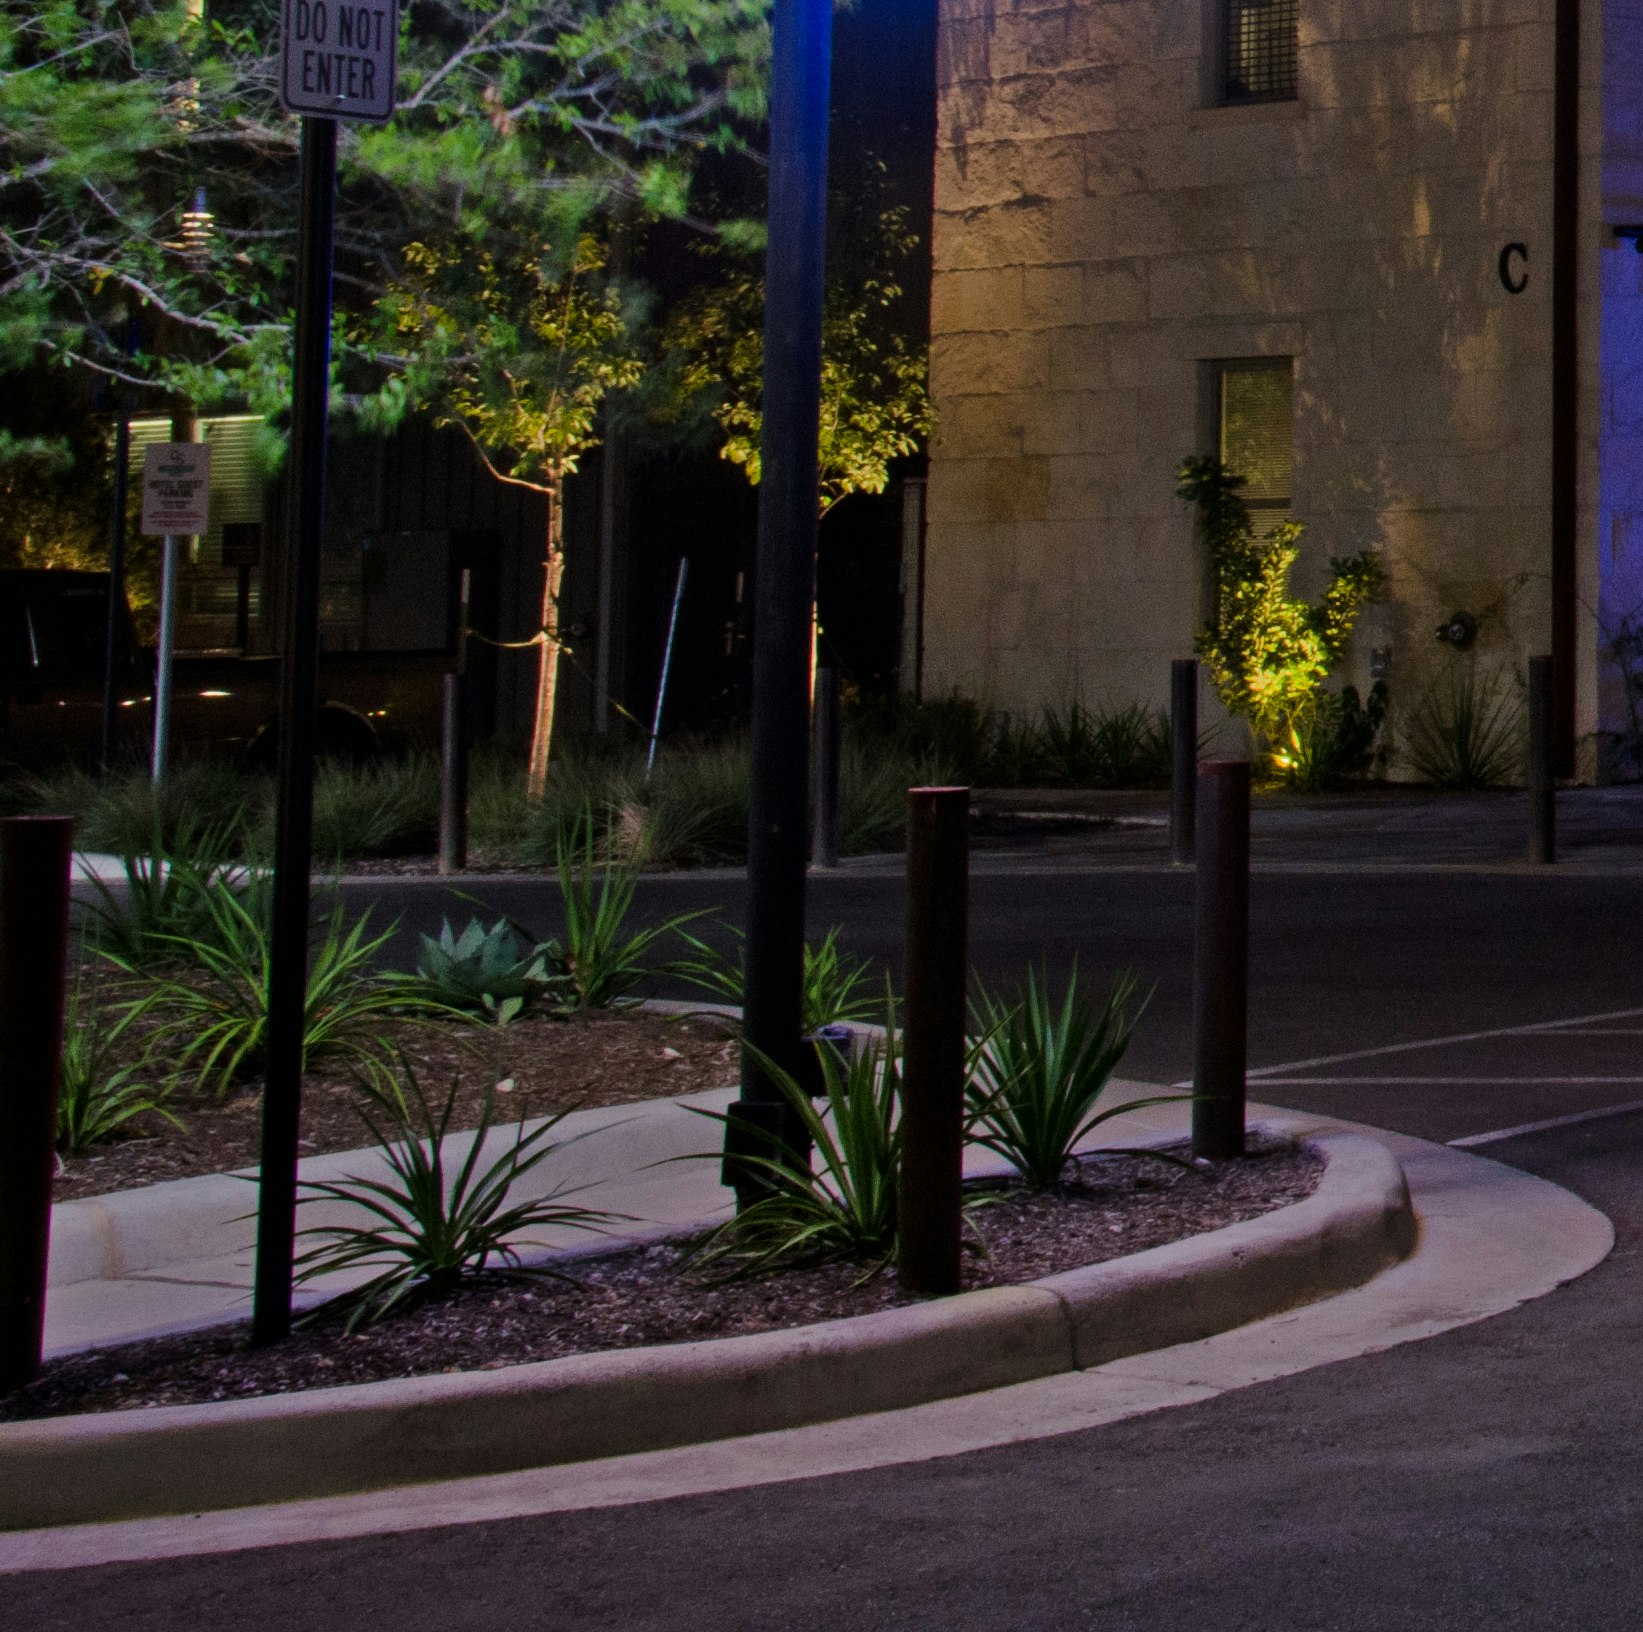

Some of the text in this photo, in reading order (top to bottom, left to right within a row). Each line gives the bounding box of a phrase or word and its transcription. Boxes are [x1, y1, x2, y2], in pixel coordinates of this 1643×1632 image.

[296, 0, 385, 52] DO NOT
[303, 50, 375, 100] ENTER
[1499, 242, 1528, 294] C
